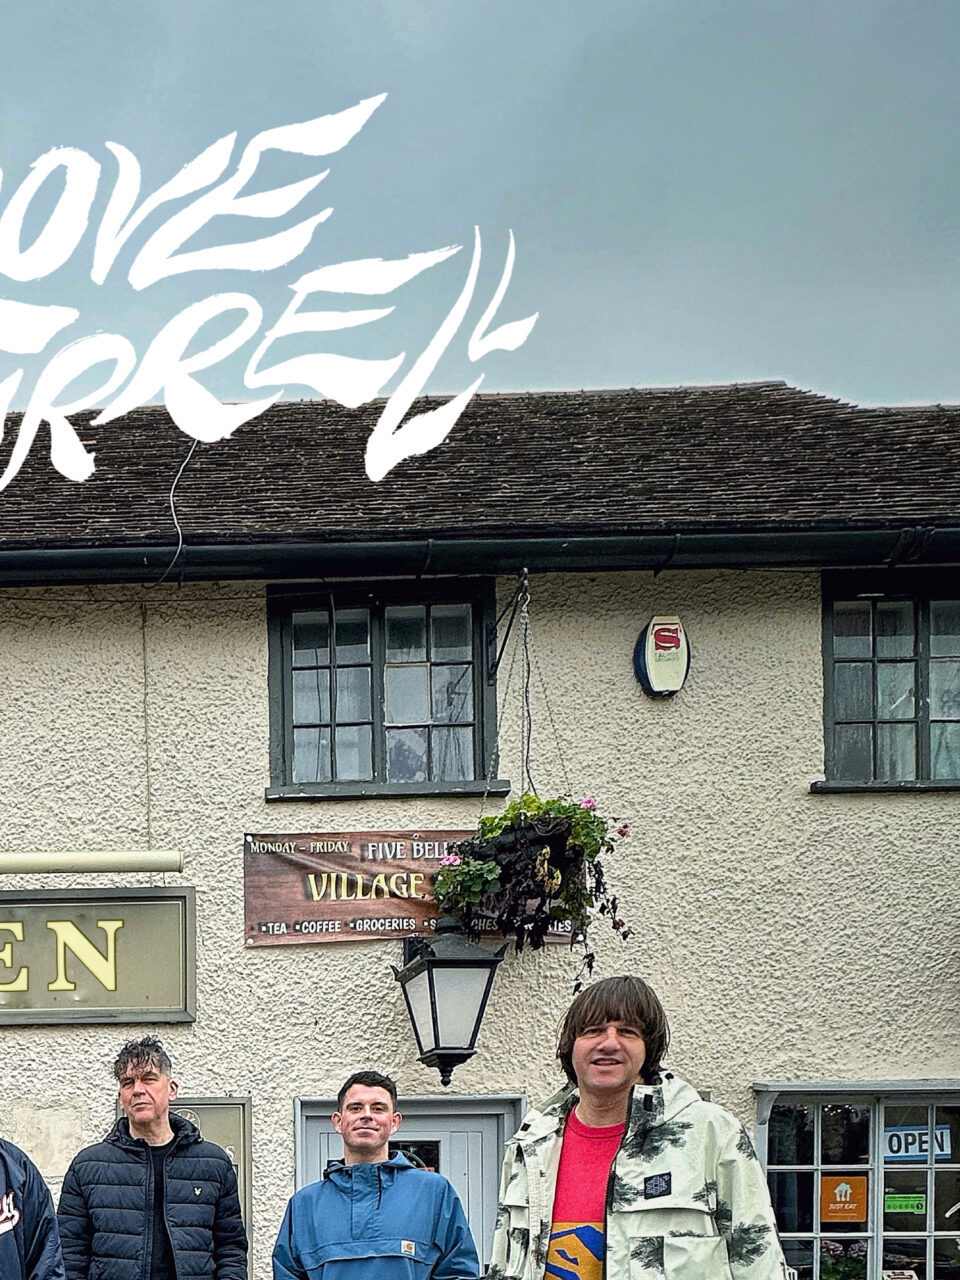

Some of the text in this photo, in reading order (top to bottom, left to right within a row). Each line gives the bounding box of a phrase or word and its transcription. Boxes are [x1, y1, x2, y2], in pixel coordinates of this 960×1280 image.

[250, 842, 296, 853] MONDAY
[310, 841, 349, 853] FRIDAY
[367, 842, 450, 859] FIVE BELL
[308, 872, 425, 901] VILLAGE
[268, 922, 288, 934] TEA
[301, 920, 342, 933] COFFEE
[356, 918, 416, 931] GROCERIES
[888, 1131, 945, 1154] OPEN
